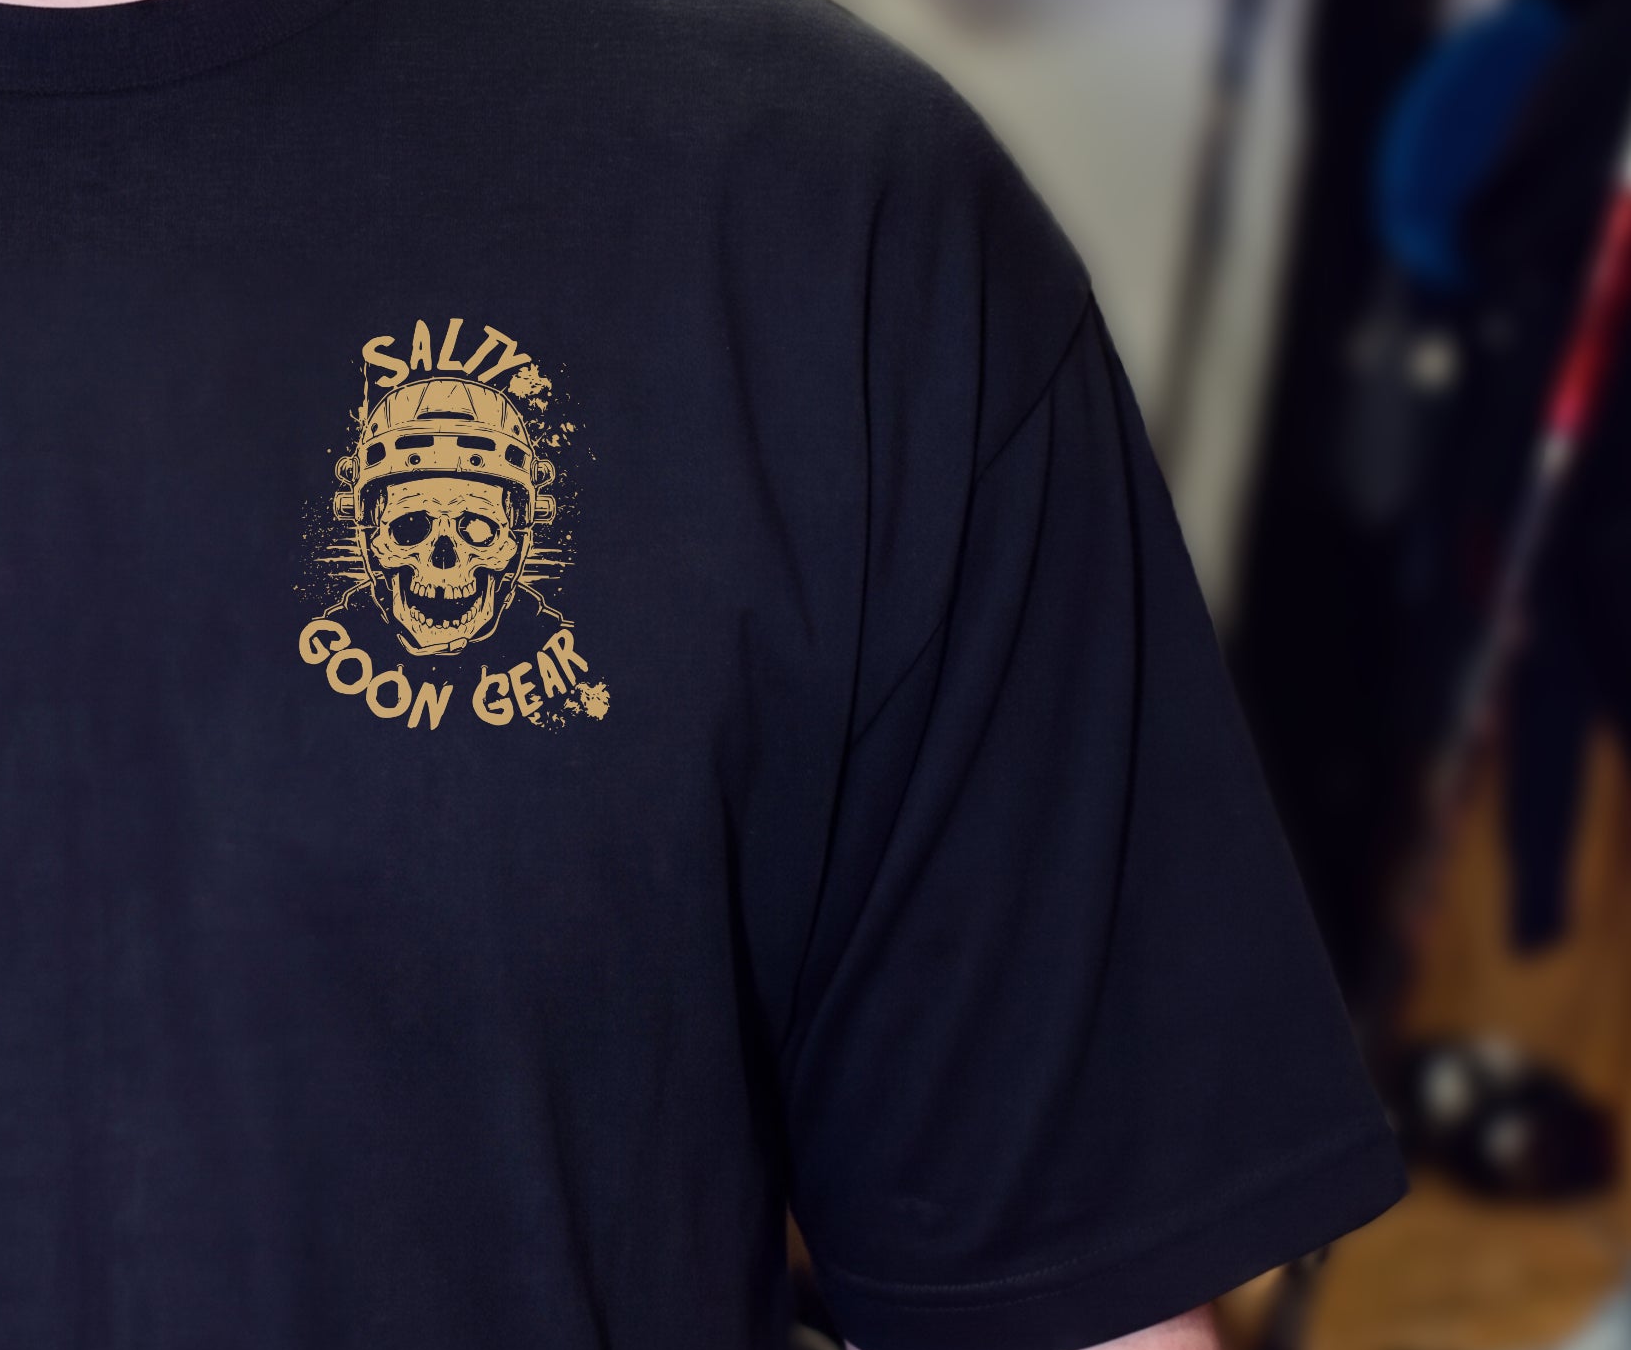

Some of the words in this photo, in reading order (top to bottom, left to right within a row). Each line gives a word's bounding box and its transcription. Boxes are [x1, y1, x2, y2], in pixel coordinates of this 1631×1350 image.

[362, 318, 531, 388] SALTY
[299, 620, 453, 730] GOON
[473, 628, 588, 726] GEAR
